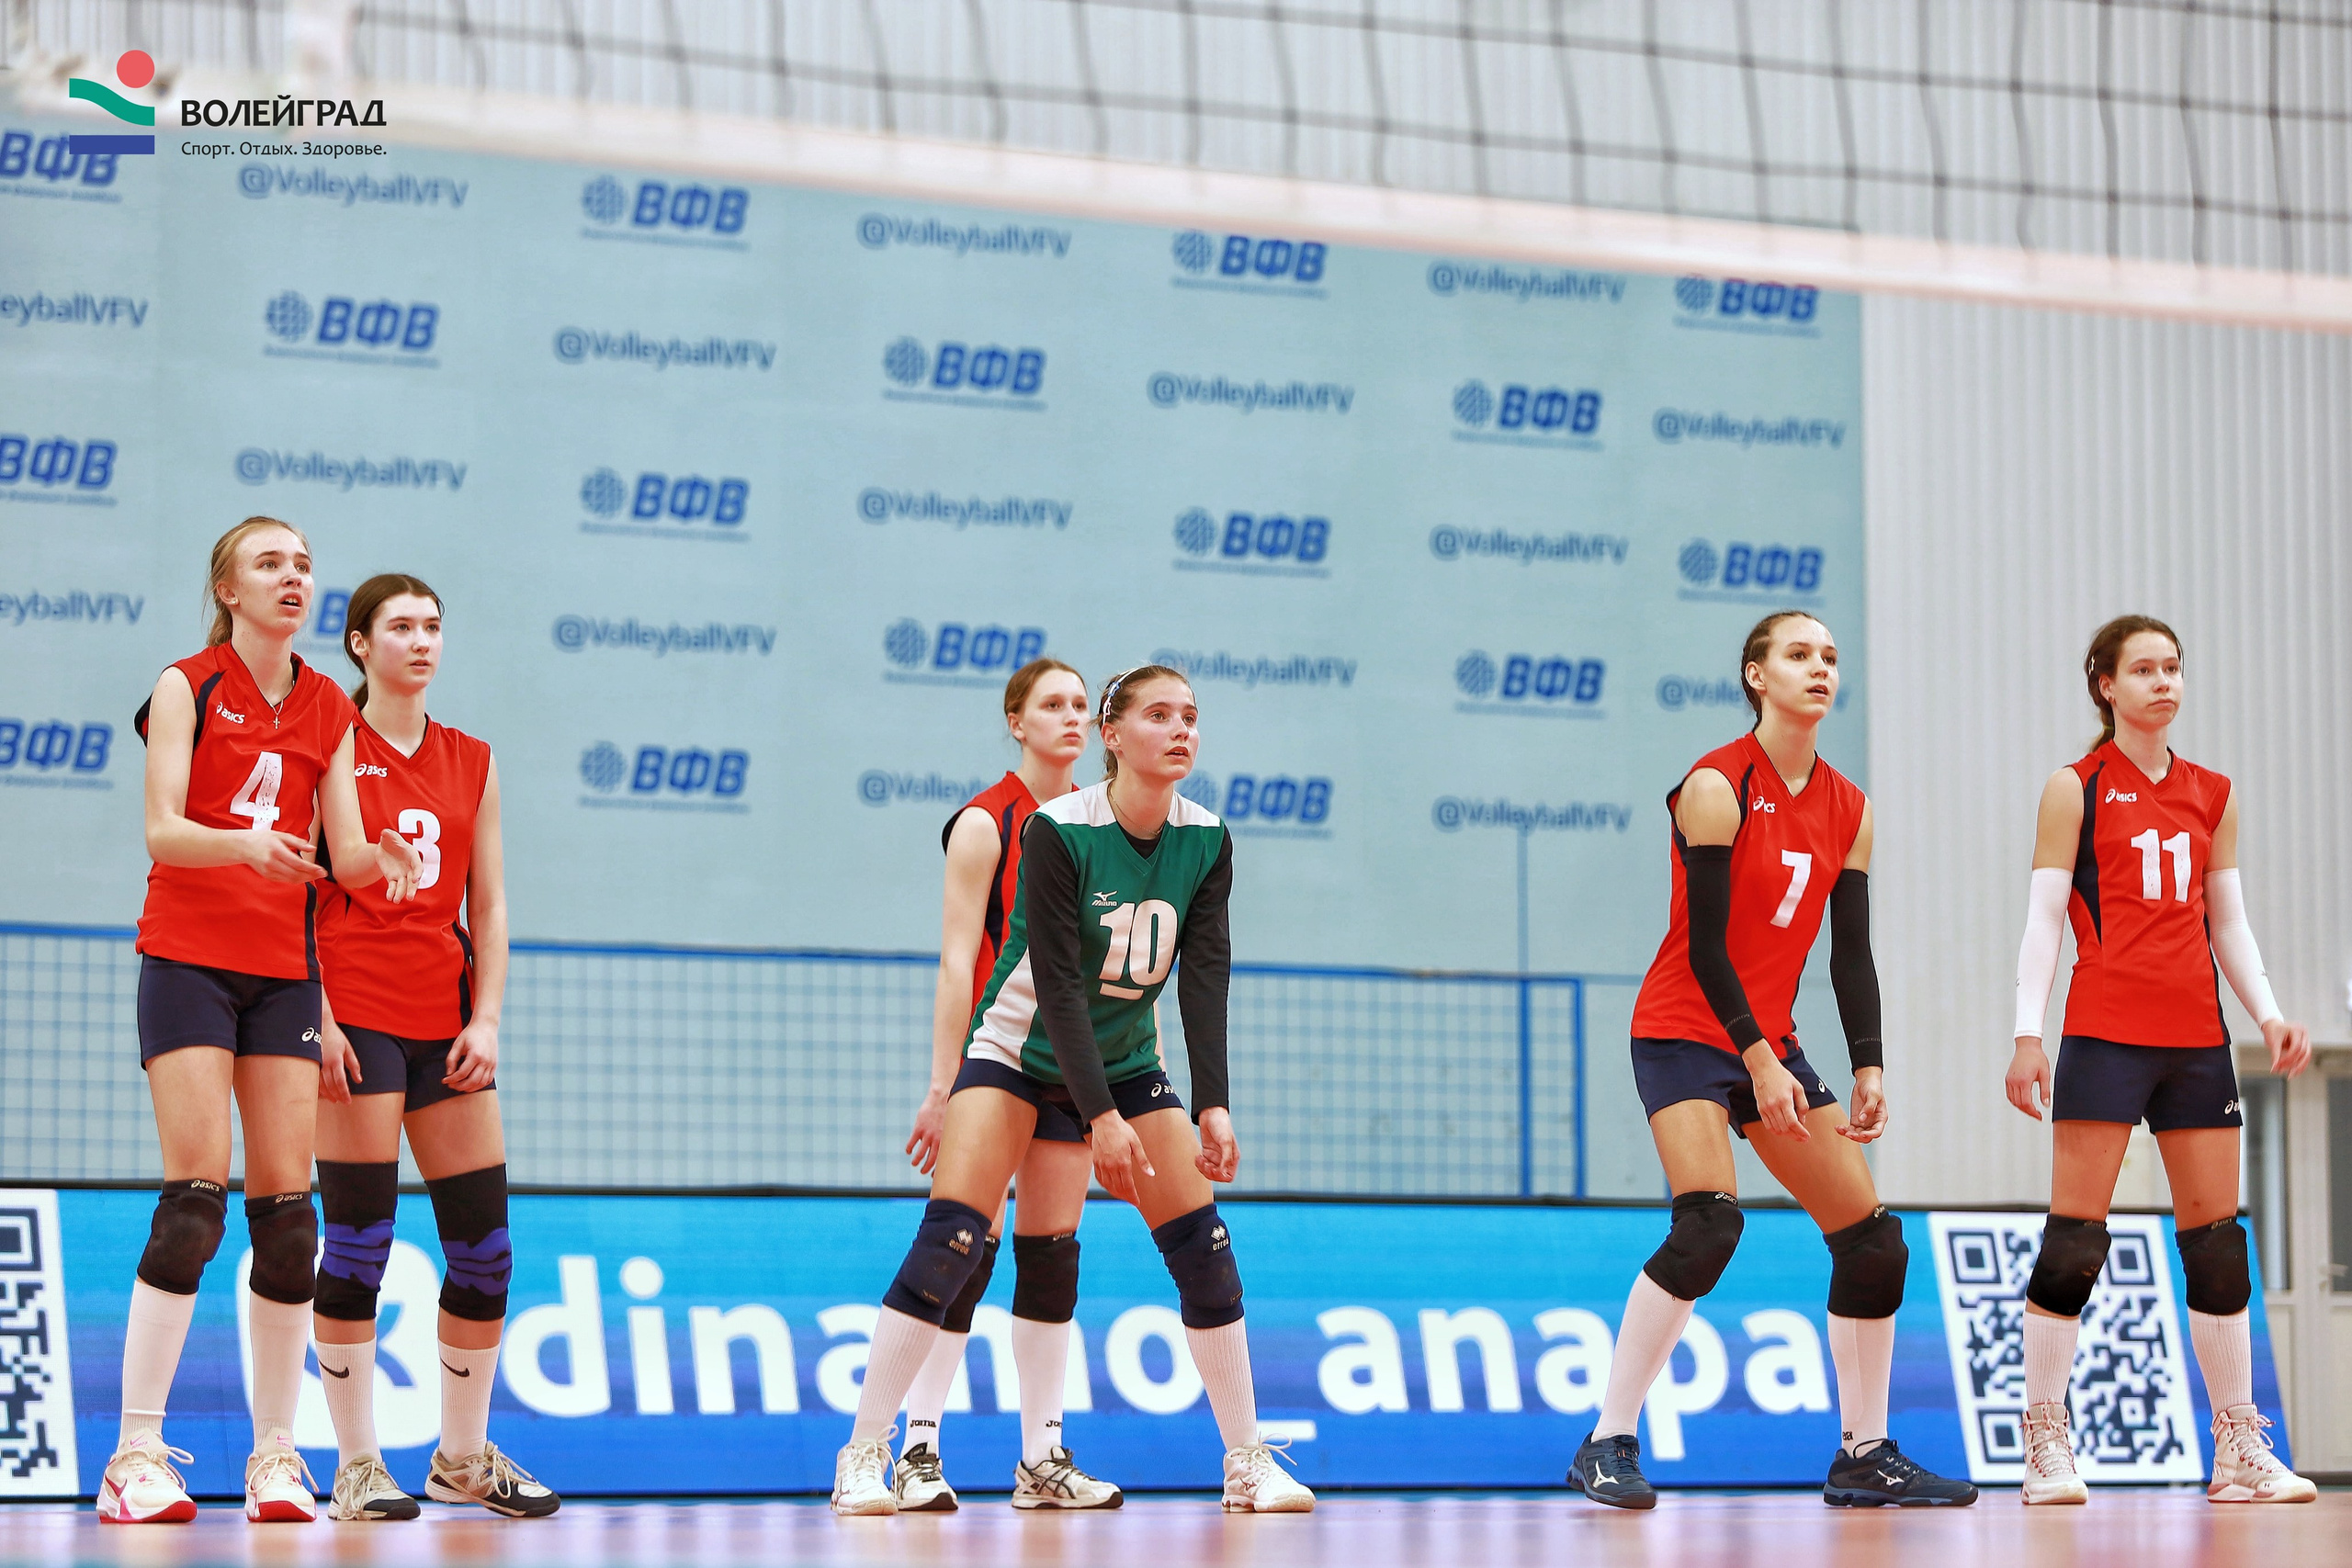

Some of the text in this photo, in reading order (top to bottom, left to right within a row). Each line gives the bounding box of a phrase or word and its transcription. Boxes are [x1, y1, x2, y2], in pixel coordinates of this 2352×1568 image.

[631, 181, 750, 234] ВФВ
[1218, 235, 1328, 283] ВФВ
[316, 298, 438, 352] ВФВ
[1718, 280, 1818, 322] ВФВ
[931, 343, 1046, 396] ВФВ
[1498, 385, 1602, 435] ВФВ
[631, 474, 749, 525] ВФВ
[1220, 513, 1330, 563] ВФВ
[1721, 544, 1825, 593] ВФВ
[932, 624, 1045, 673] ВФВ
[1500, 655, 1605, 704] ВФВ
[221, 709, 245, 724] asics
[231, 751, 281, 830] 4
[630, 747, 749, 797] ВФВ
[1220, 775, 1332, 825] ВФВ
[2115, 792, 2137, 803] asics
[396, 808, 440, 889] 3
[2131, 828, 2191, 903] 11
[1770, 849, 1813, 929] 7
[1098, 899, 1176, 985] 10
[199, 1181, 220, 1192] asics
[503, 1255, 1833, 1461] dinamo_anapa
